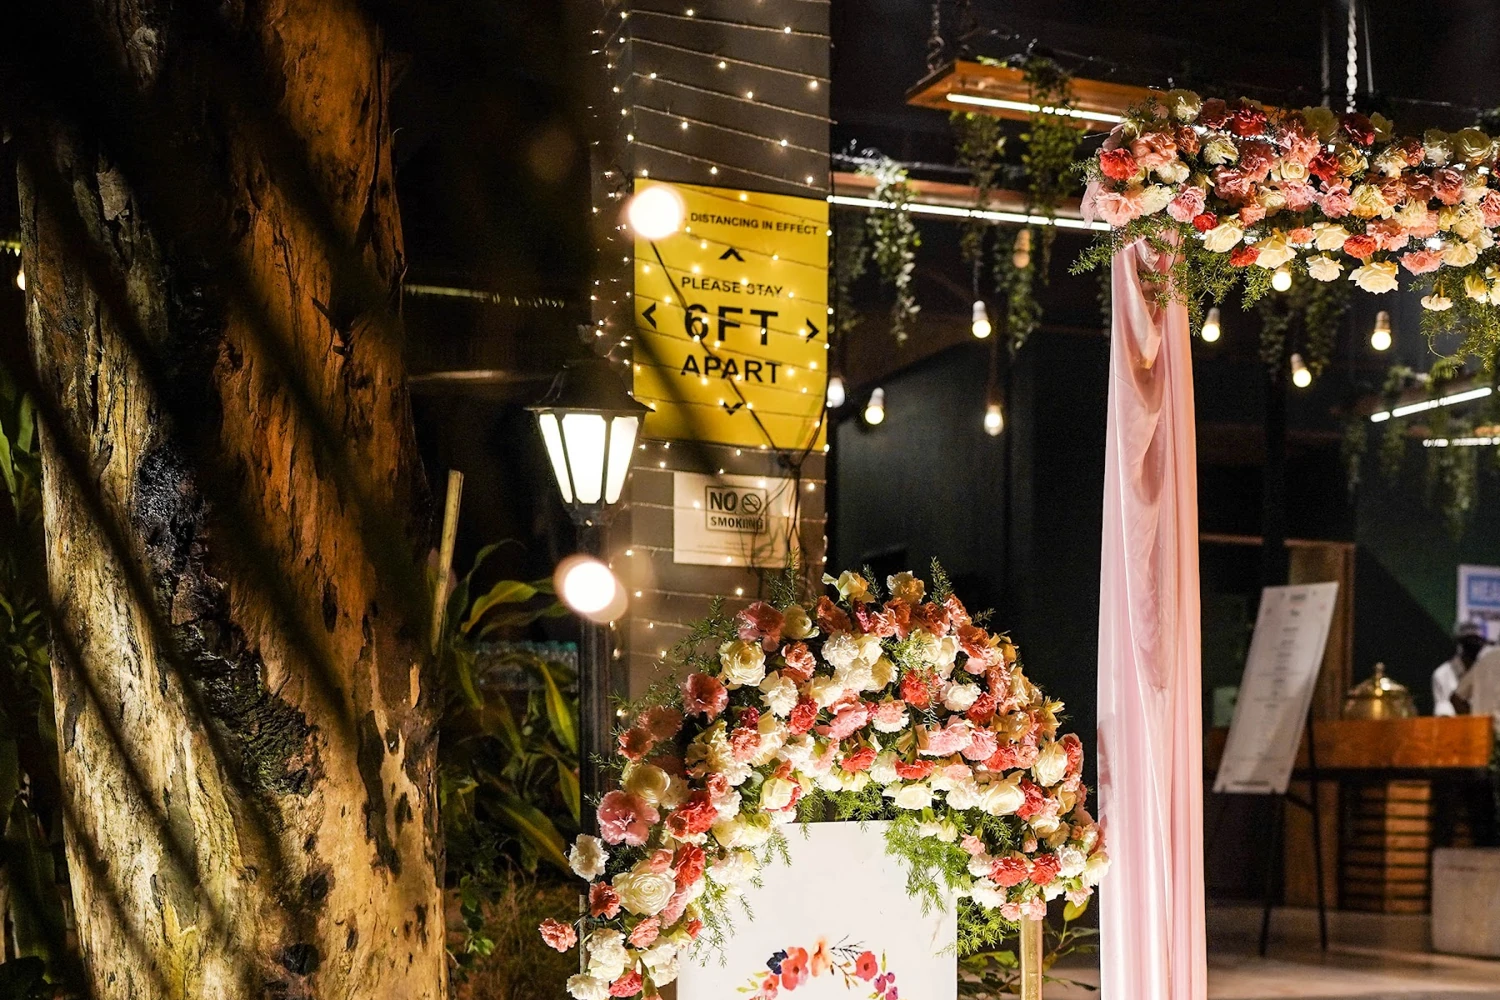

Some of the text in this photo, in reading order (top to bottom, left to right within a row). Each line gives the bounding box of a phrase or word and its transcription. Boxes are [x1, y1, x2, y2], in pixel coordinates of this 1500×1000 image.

[690, 212, 818, 235] DISTANCING IN EFFECT
[681, 277, 783, 297] PLEASE STAY
[684, 304, 778, 345] 6FT
[681, 354, 781, 384] APART
[710, 491, 738, 511] NO
[710, 516, 764, 530] SMOKING
